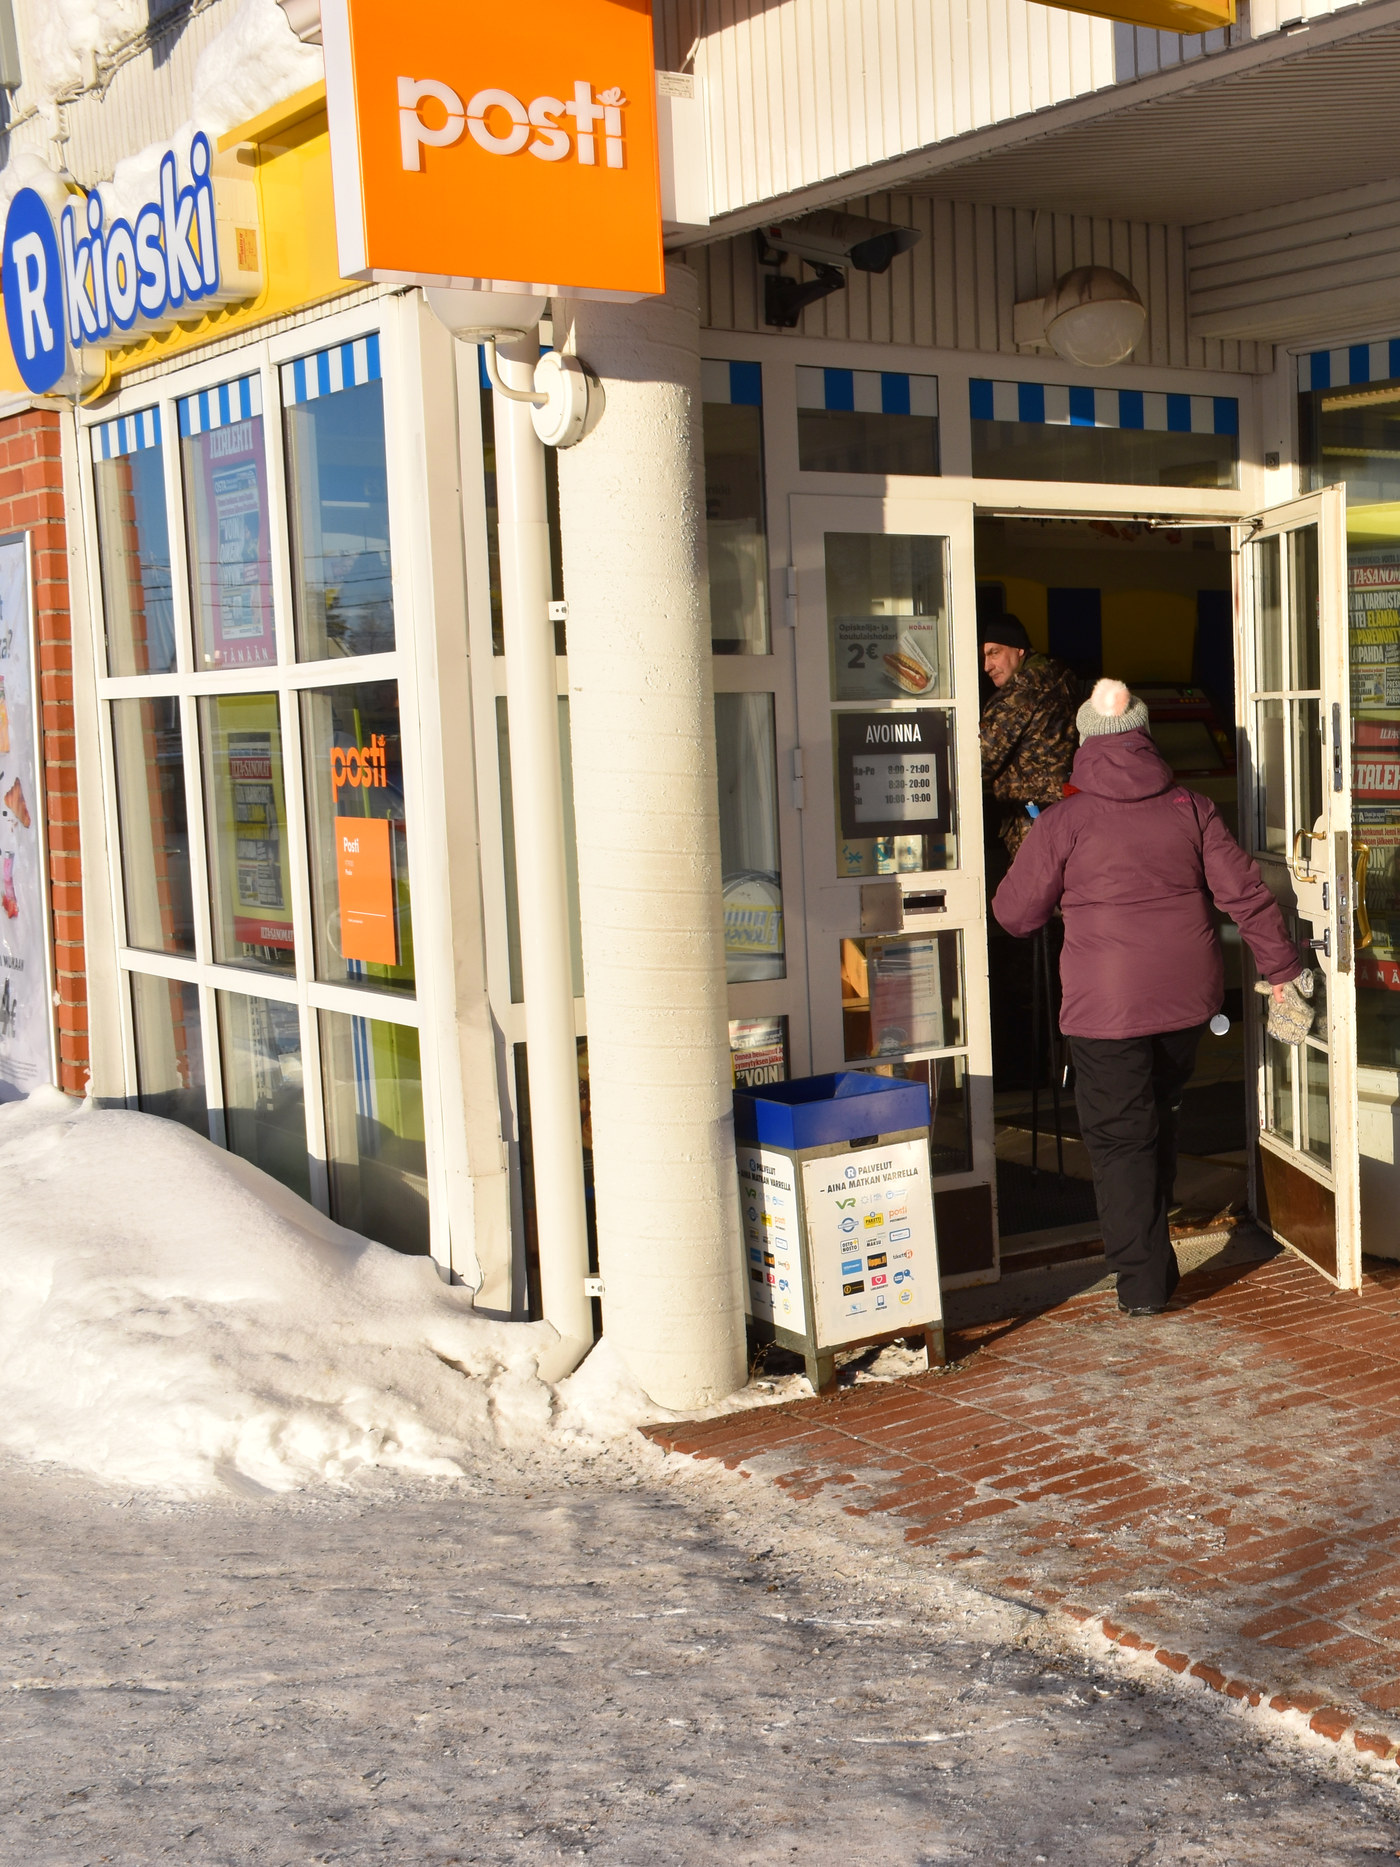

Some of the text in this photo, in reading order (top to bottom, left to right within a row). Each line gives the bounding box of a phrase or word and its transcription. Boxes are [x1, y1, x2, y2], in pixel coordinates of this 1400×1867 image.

[397, 75, 626, 172] posti
[12, 136, 219, 361] R kioski
[866, 724, 922, 743] AVOINNA
[329, 733, 387, 803] posti
[910, 764, 930, 774] 21:00
[909, 778, 930, 789] 20:00
[911, 793, 931, 803] 19:00
[343, 836, 360, 854] Posti
[858, 1160, 893, 1176] PALVELUT
[827, 1182, 847, 1194] AINA
[849, 1174, 881, 1190] MATKAN
[883, 1167, 919, 1182] VARRELLA
[835, 1197, 857, 1210] VR
[888, 1206, 908, 1219] posti
